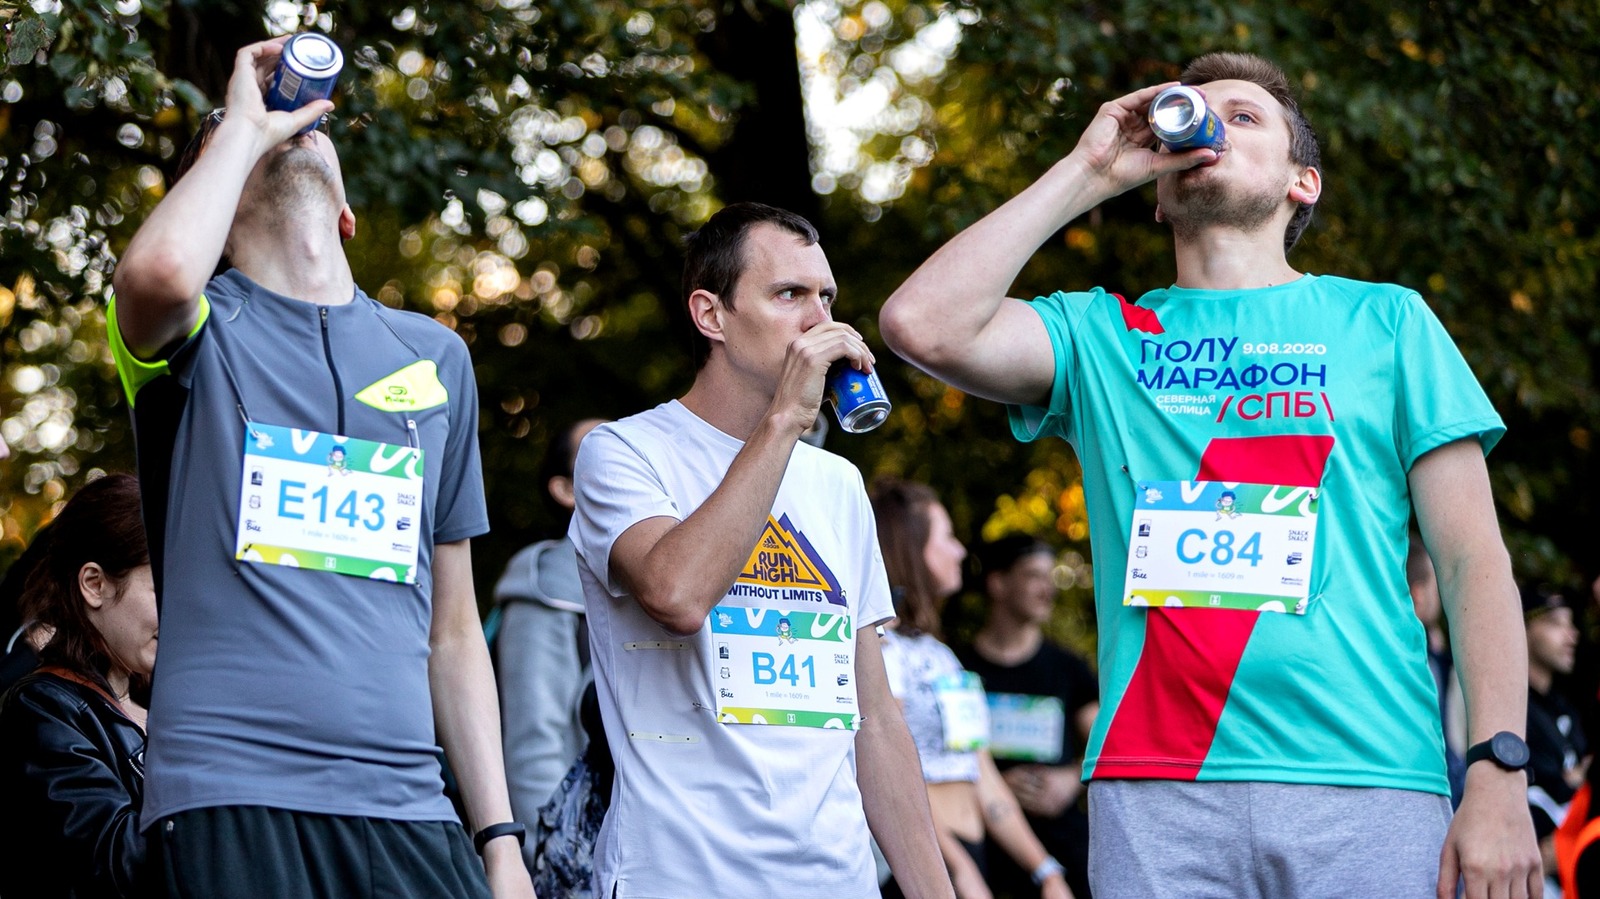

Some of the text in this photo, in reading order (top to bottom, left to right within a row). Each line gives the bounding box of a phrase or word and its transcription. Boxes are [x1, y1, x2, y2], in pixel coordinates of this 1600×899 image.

[1140, 336, 1239, 364] ПОЛУ
[1242, 343, 1327, 355] 9.08.2020
[1136, 362, 1327, 390] МАРАФОН
[1155, 394, 1216, 404] СЕВЕРНАЯ
[396, 499, 416, 507] SNACK
[397, 492, 416, 500] SNACK
[277, 479, 386, 532] E143
[1176, 528, 1263, 567] C84
[758, 551, 793, 568] RUN
[753, 564, 796, 583] HIGH
[1217, 572, 1235, 580] 1609
[728, 584, 823, 602] WITHOUT LIMITS
[752, 651, 816, 688] B41
[789, 692, 803, 700] 1609
